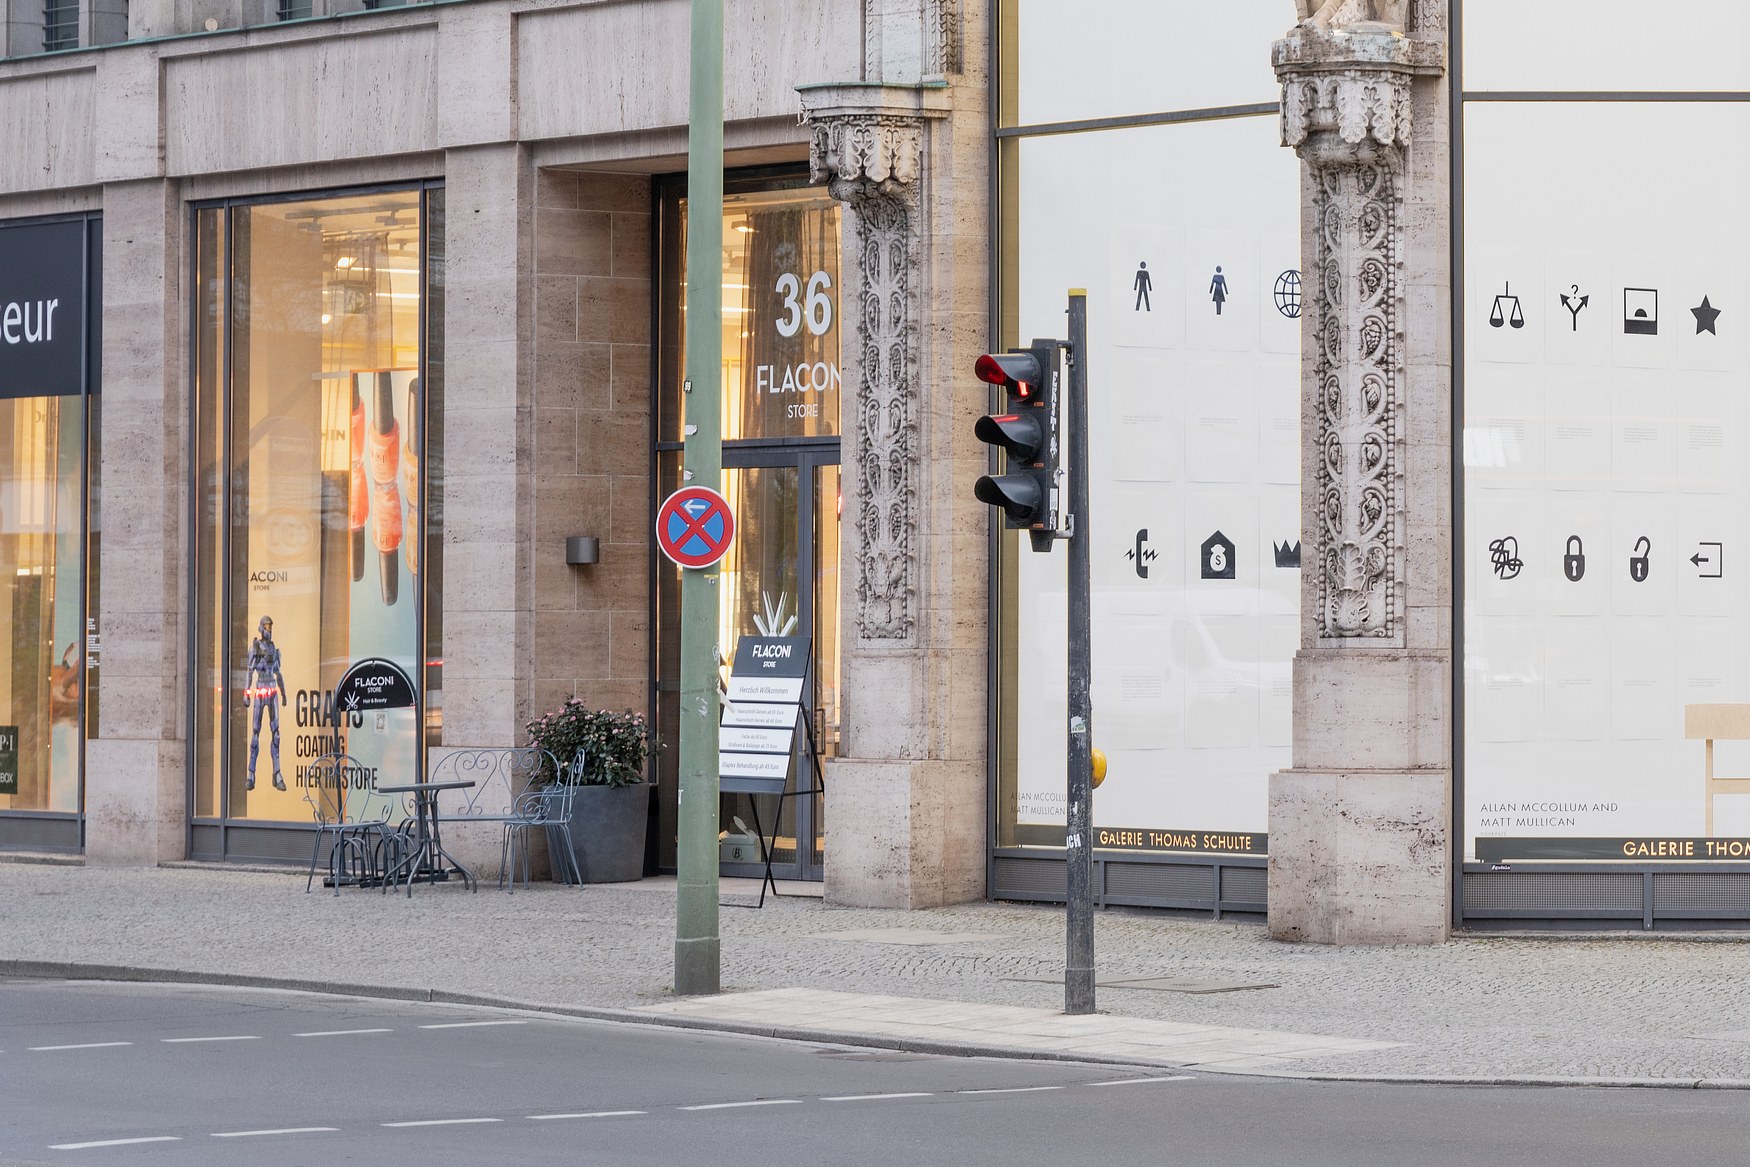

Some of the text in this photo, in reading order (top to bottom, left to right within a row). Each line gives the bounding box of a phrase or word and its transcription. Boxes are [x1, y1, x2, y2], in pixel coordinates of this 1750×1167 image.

[775, 270, 832, 337] 36
[0, 298, 58, 344] eur
[787, 404, 818, 419] STORE
[248, 571, 288, 582] ACONI
[752, 644, 792, 658] FLACONI
[763, 660, 776, 668] STORE
[355, 676, 394, 688] FLACONI
[739, 685, 788, 695] Herzlich Willkommen
[0, 772, 13, 783] BOX
[296, 765, 322, 788] HIER
[341, 766, 378, 790] STORE
[1010, 792, 1067, 802] ALLAN MCCOLLU
[1010, 805, 1066, 816] MATT MULLICAN
[1480, 803, 1619, 812] ALLAN MCCOLLUM AND
[1480, 817, 1576, 827] MATT MULLICAN
[1100, 830, 1252, 850] GALERIE THOMAS SCHULTE
[1623, 841, 1694, 856] GALERIE
